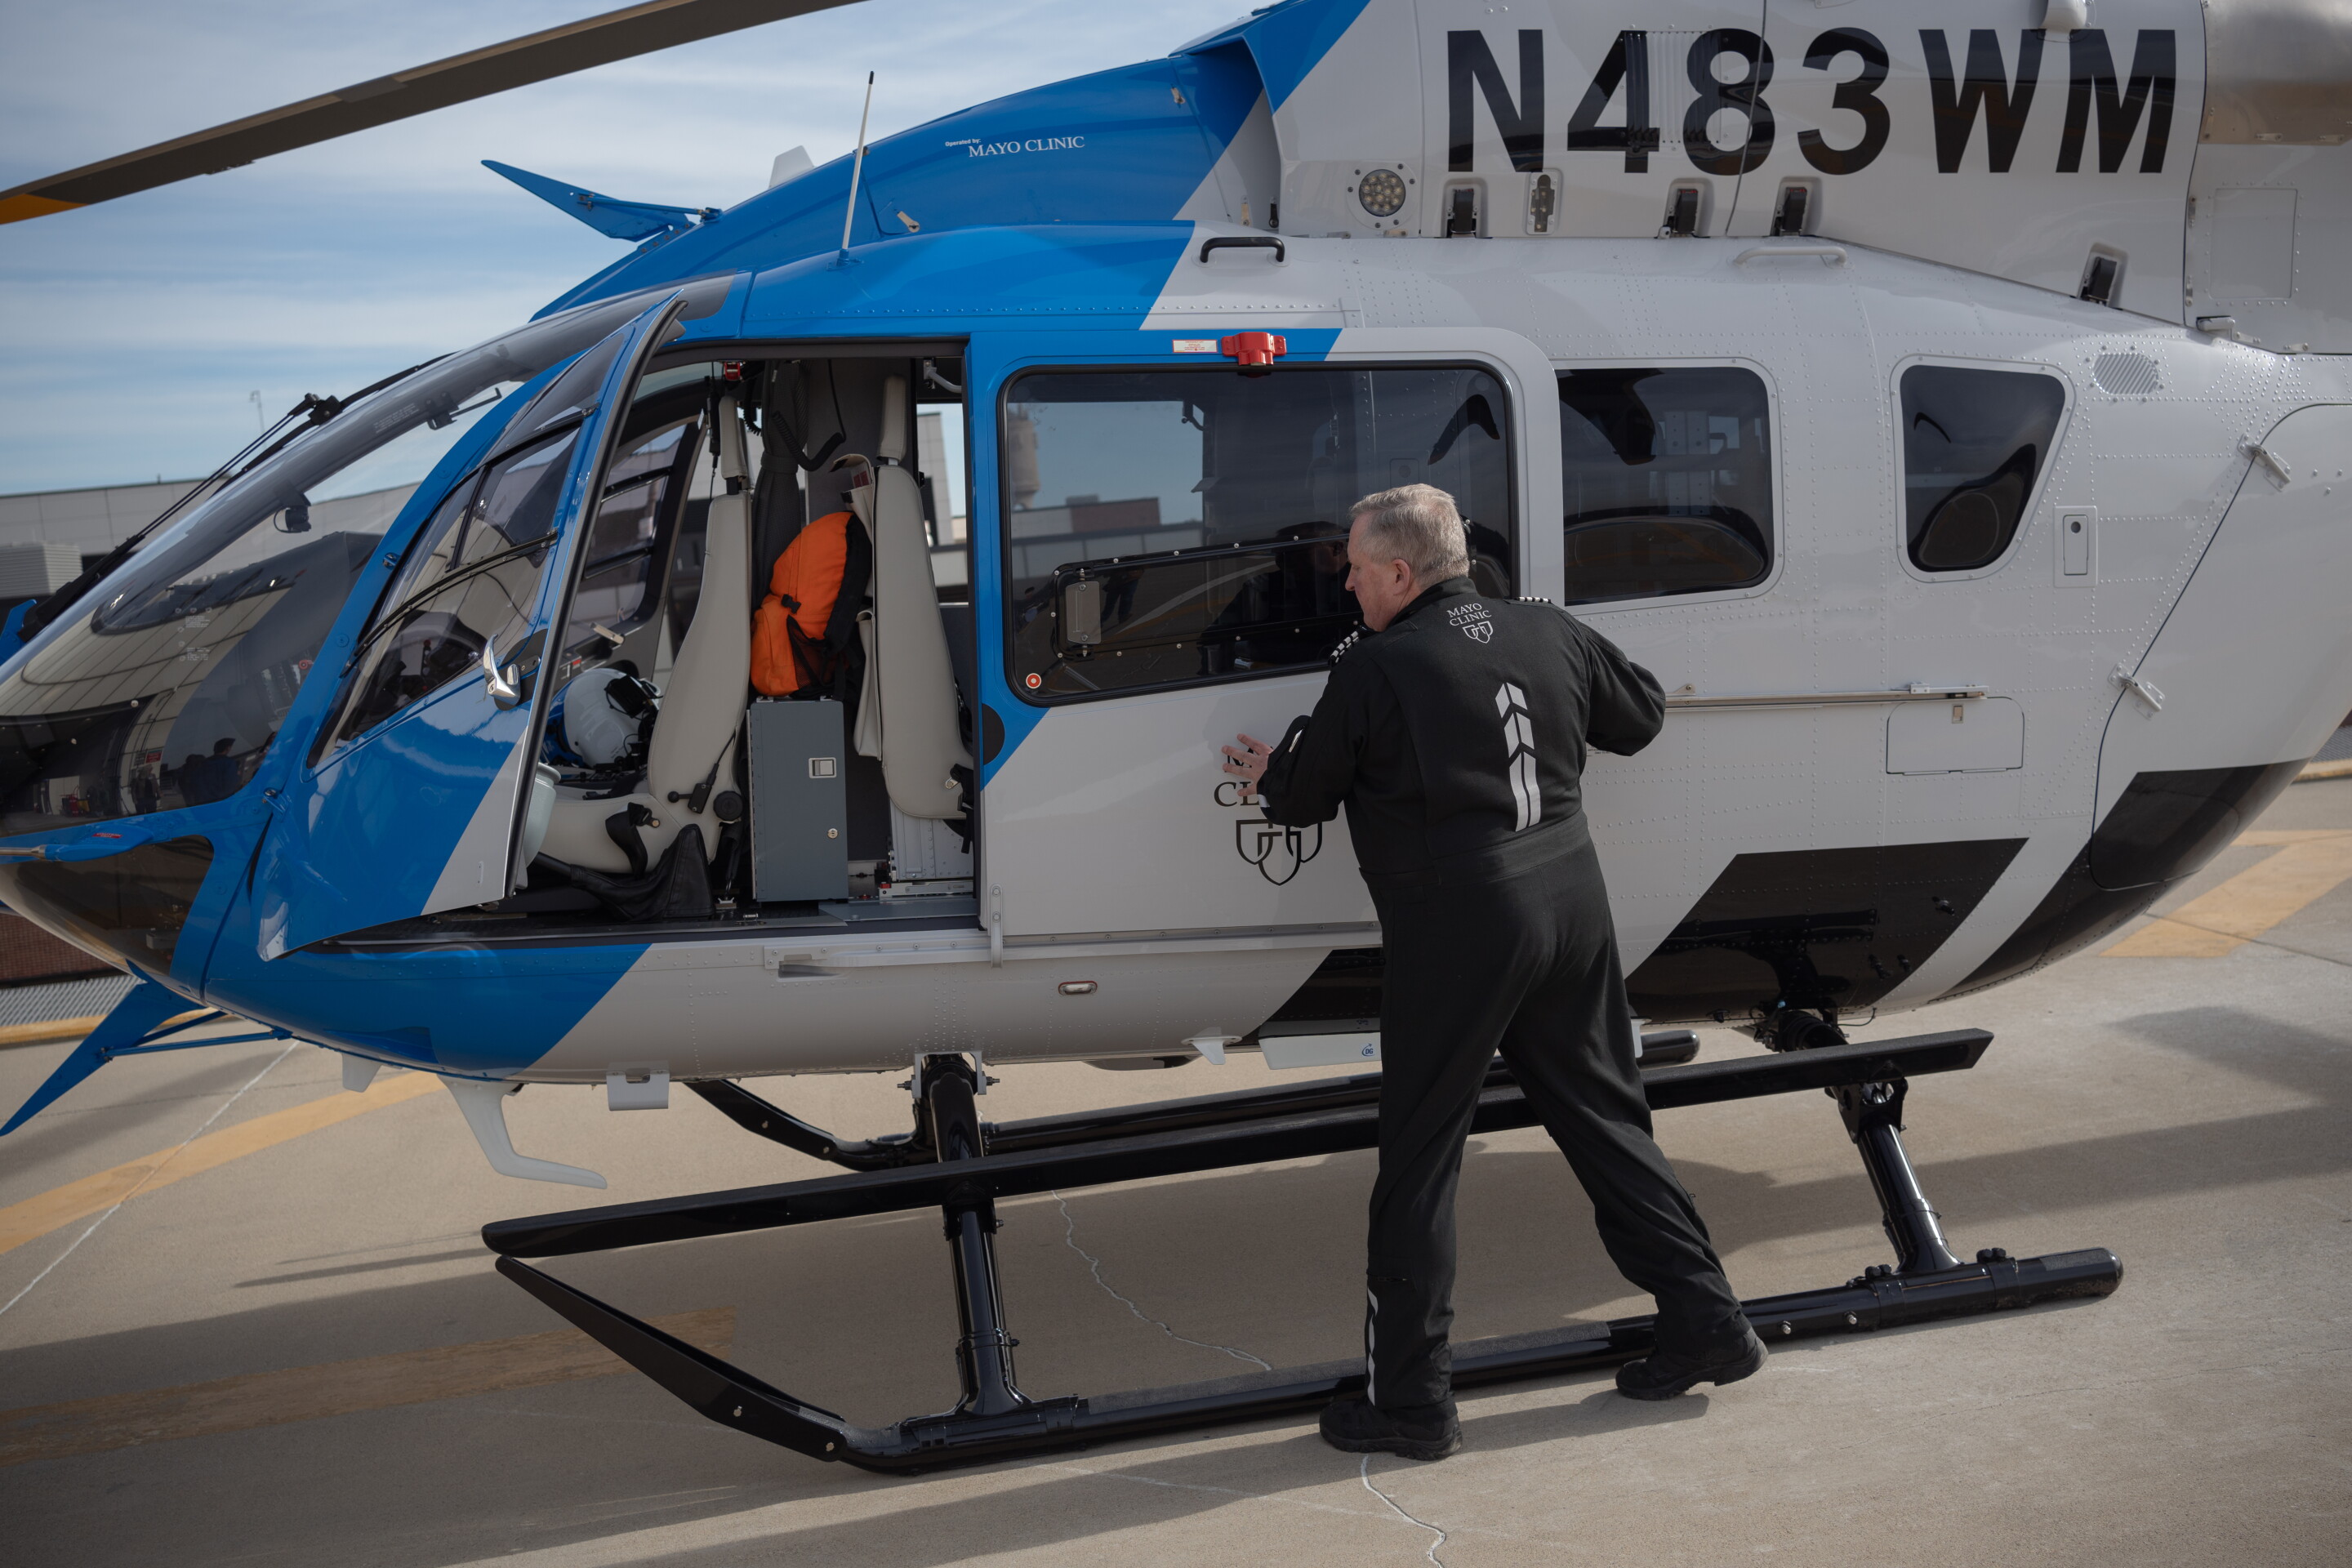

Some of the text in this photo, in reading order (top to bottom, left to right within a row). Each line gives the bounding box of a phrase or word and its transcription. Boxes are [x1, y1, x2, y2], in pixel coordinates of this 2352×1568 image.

[1447, 28, 2176, 176] N483WM
[945, 139, 971, 147] Operated
[969, 136, 1085, 158] MAYO CLINIC
[1446, 603, 1482, 618] MAYO
[1449, 610, 1492, 626] CLINIC
